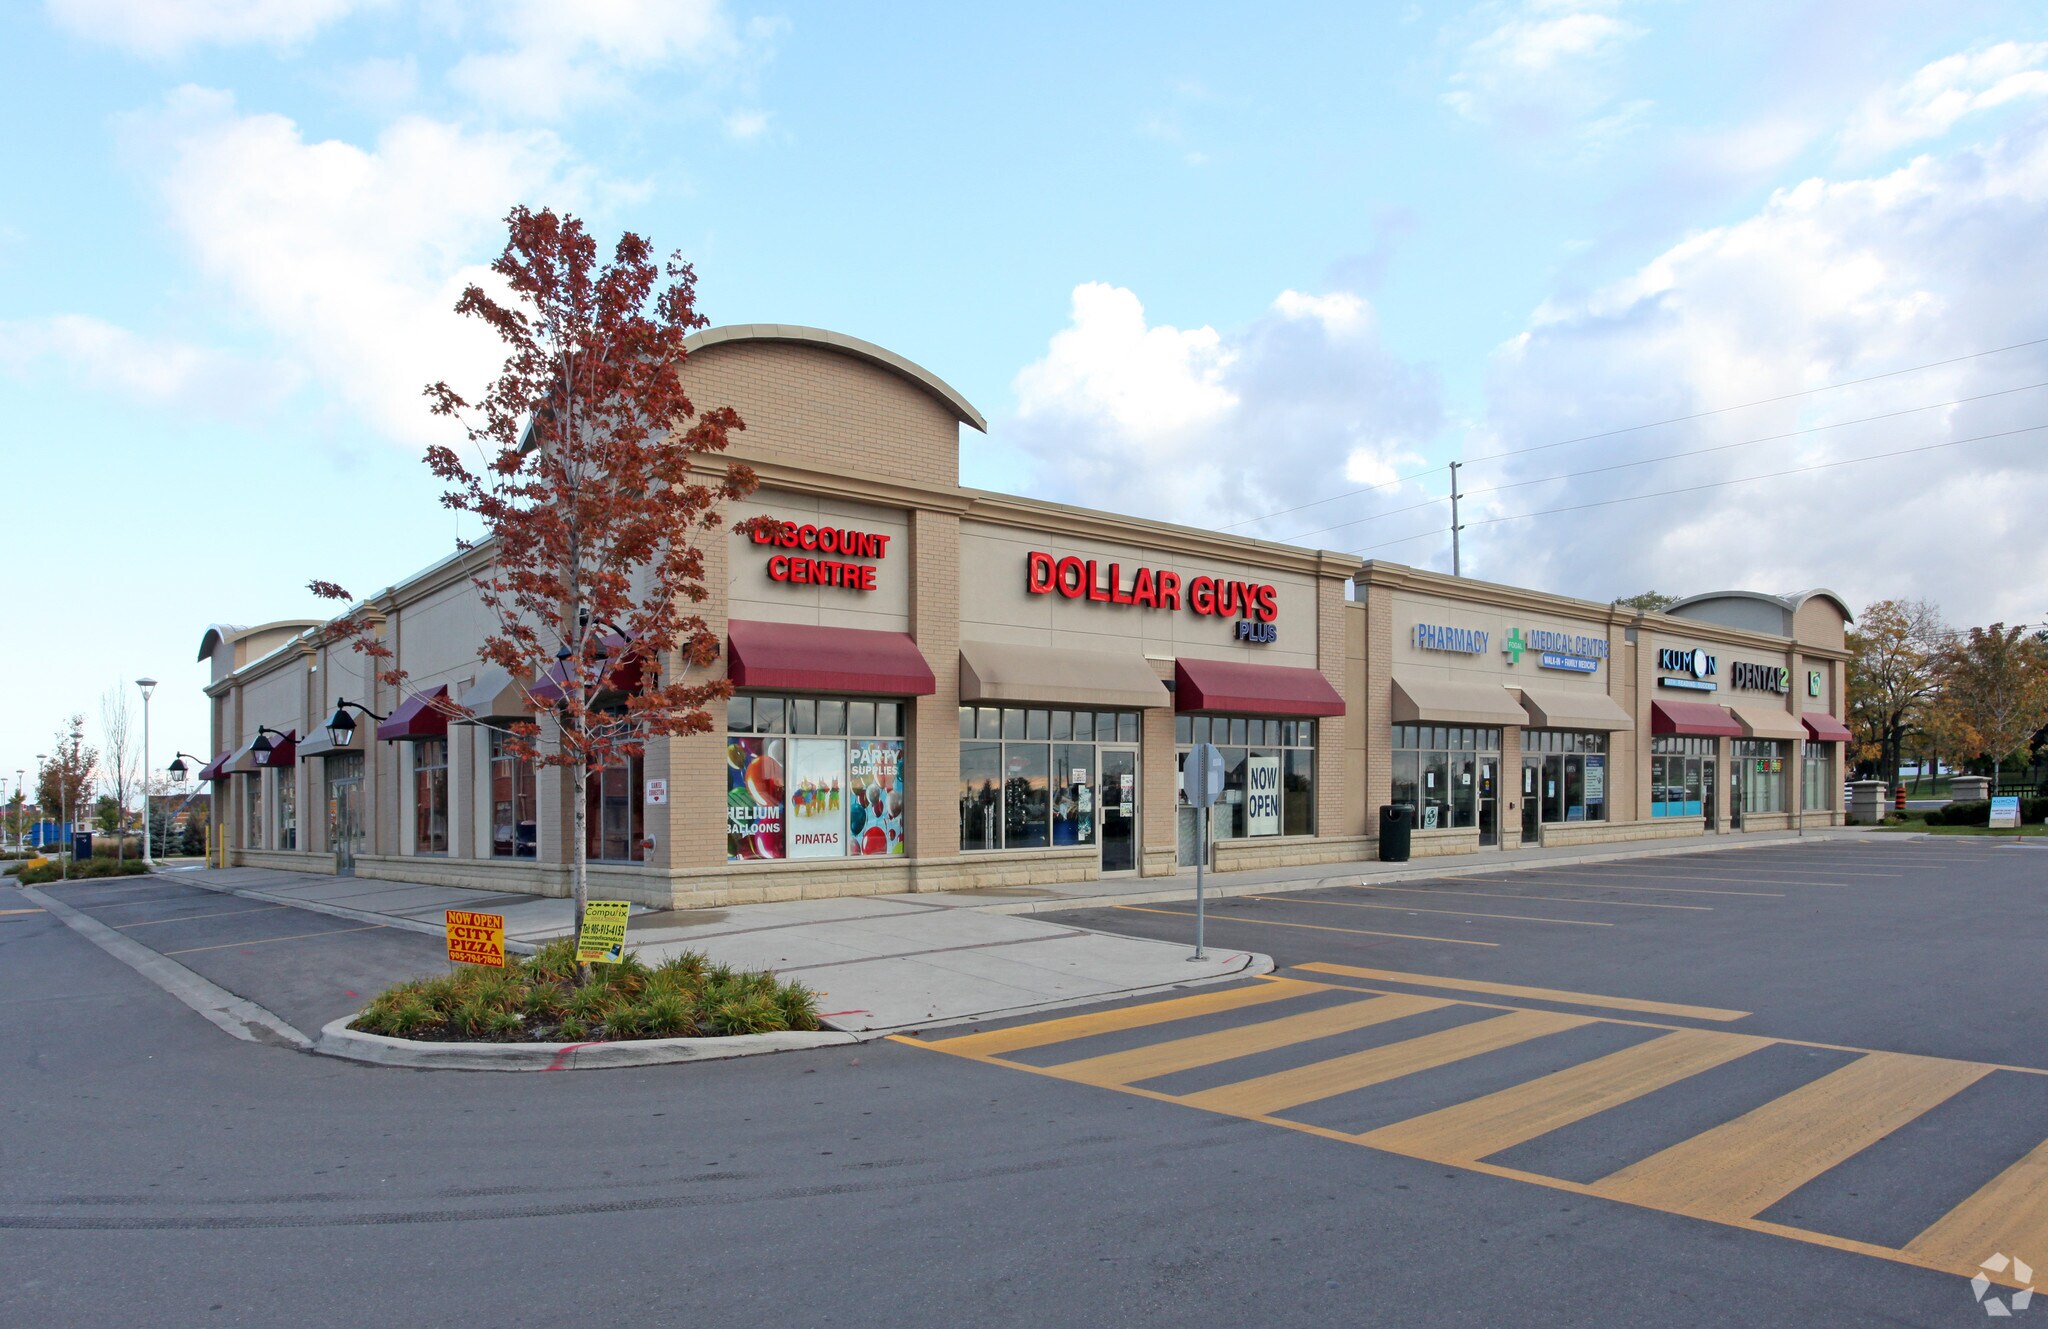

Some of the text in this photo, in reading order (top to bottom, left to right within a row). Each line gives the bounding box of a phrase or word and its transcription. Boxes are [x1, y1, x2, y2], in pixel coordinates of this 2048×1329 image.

[767, 555, 876, 590] CENTRE
[1027, 551, 1278, 622] DOLLAR GUYS
[1236, 621, 1278, 643] PLUS
[1416, 623, 1489, 653] PHARMACY
[1531, 630, 1609, 658] MEDICAL CENTRE
[1662, 648, 1717, 678] KUMON
[850, 749, 900, 765] PARTY
[851, 766, 899, 776] SUPPLIES
[1250, 766, 1277, 790] NOW
[1249, 795, 1278, 818] OPEN
[795, 833, 839, 845] PINATAS
[447, 911, 501, 928] NOW OPEN
[454, 927, 495, 941] CITY
[450, 938, 501, 955] PIZZA
